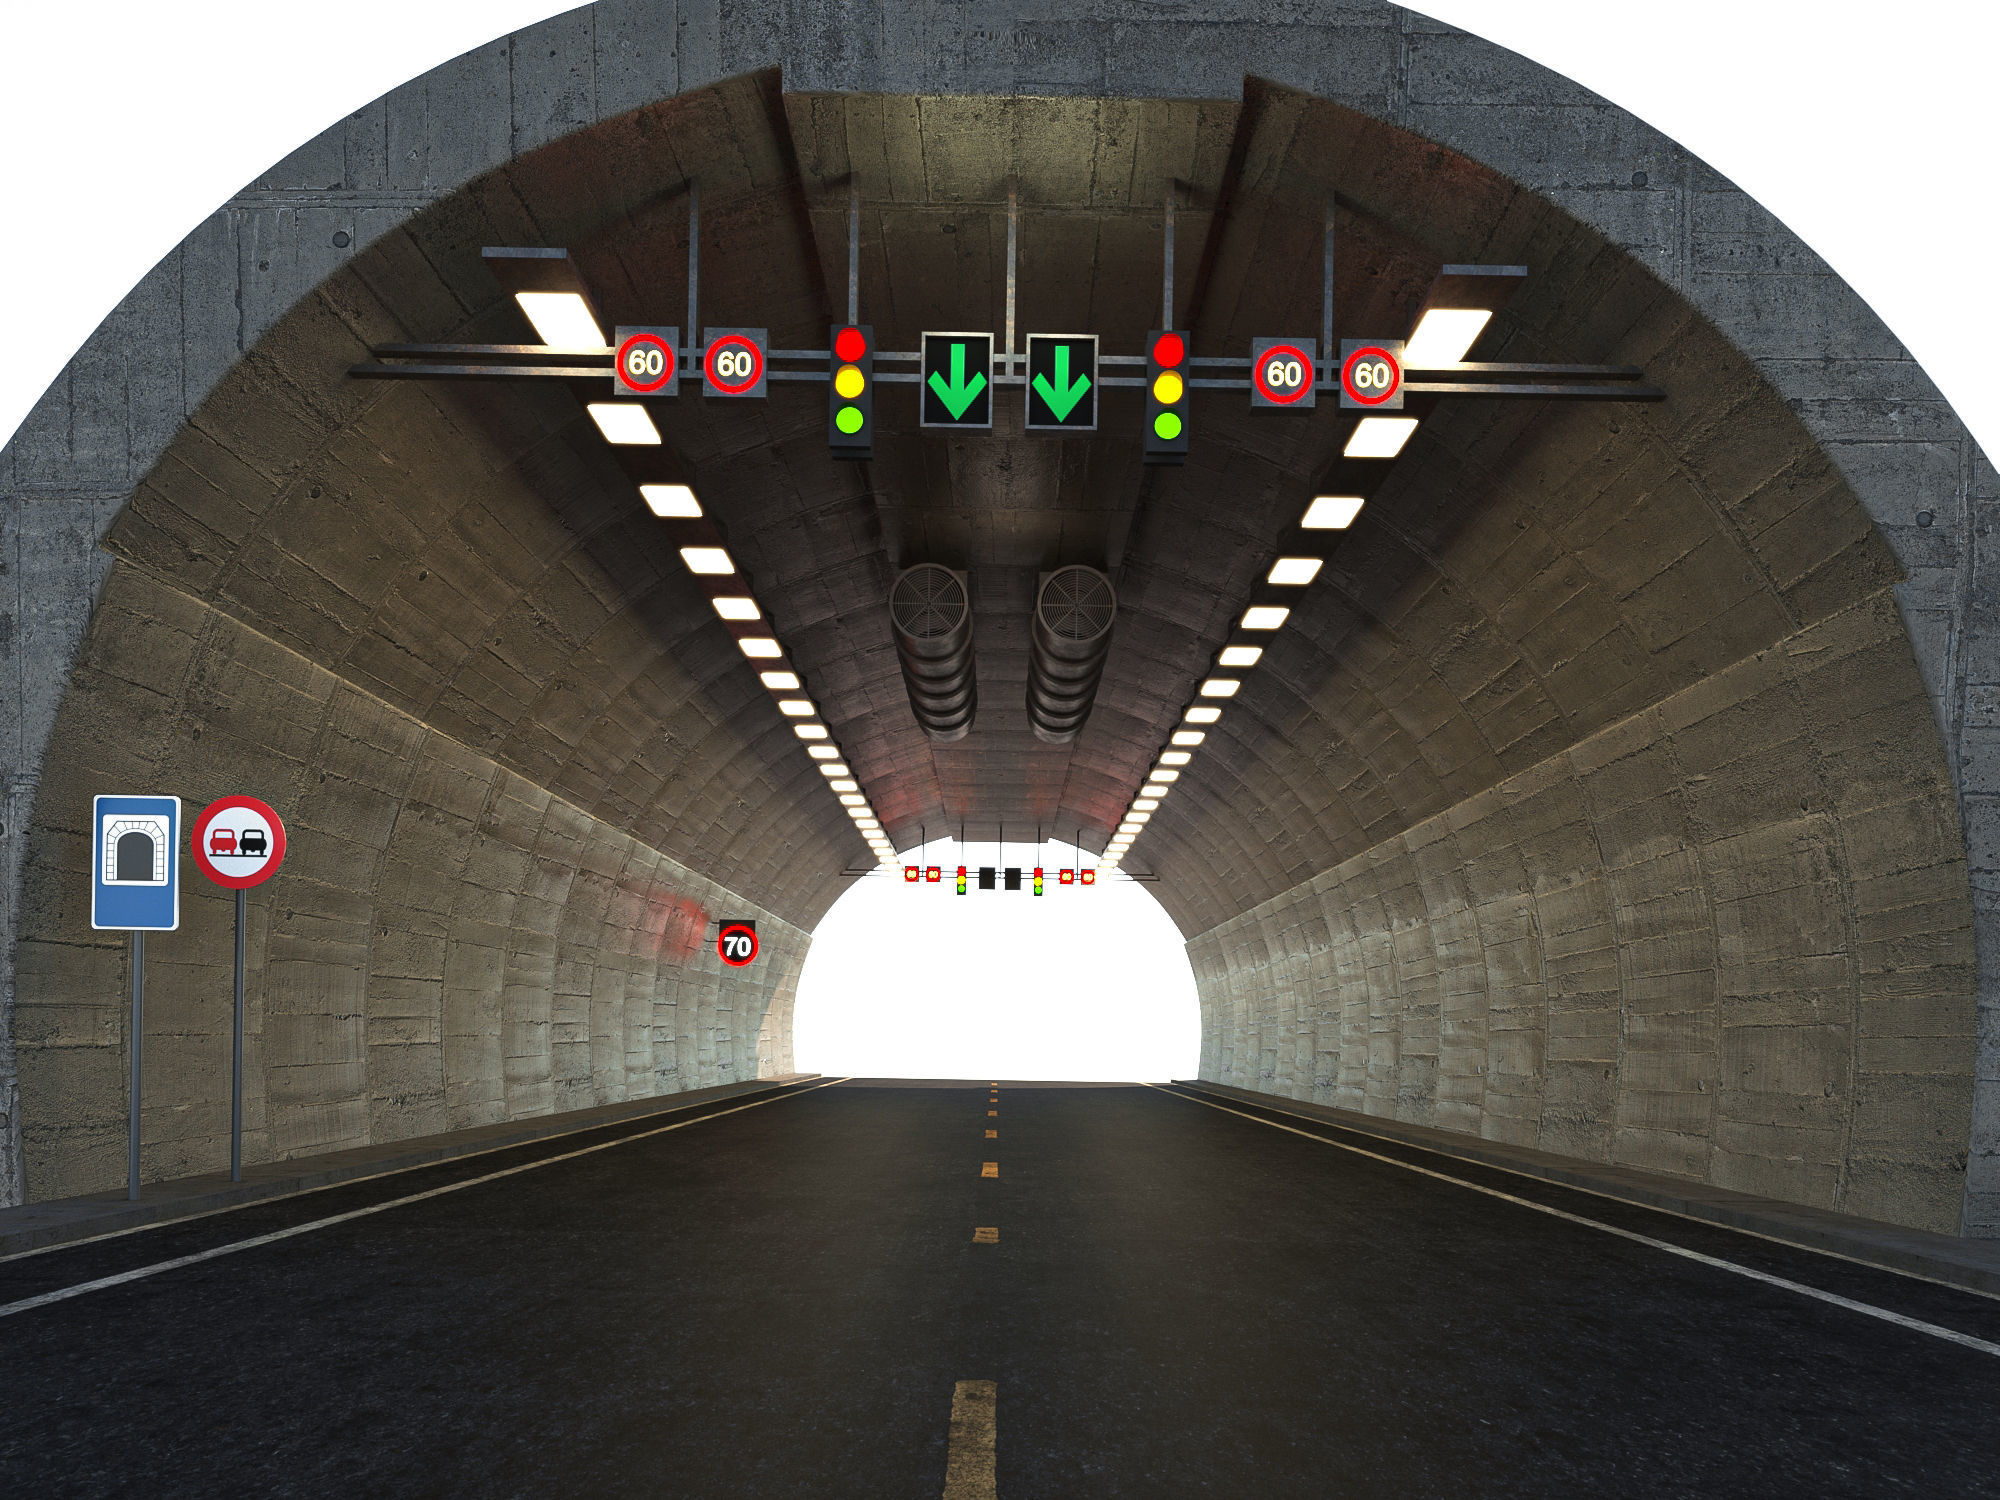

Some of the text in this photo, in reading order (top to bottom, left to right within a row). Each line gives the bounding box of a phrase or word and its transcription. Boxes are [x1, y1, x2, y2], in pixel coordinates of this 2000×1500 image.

[628, 349, 663, 376] 60
[717, 350, 752, 377] 60
[1267, 360, 1302, 387] 60
[1355, 362, 1390, 388] 60
[724, 936, 752, 957] 70
